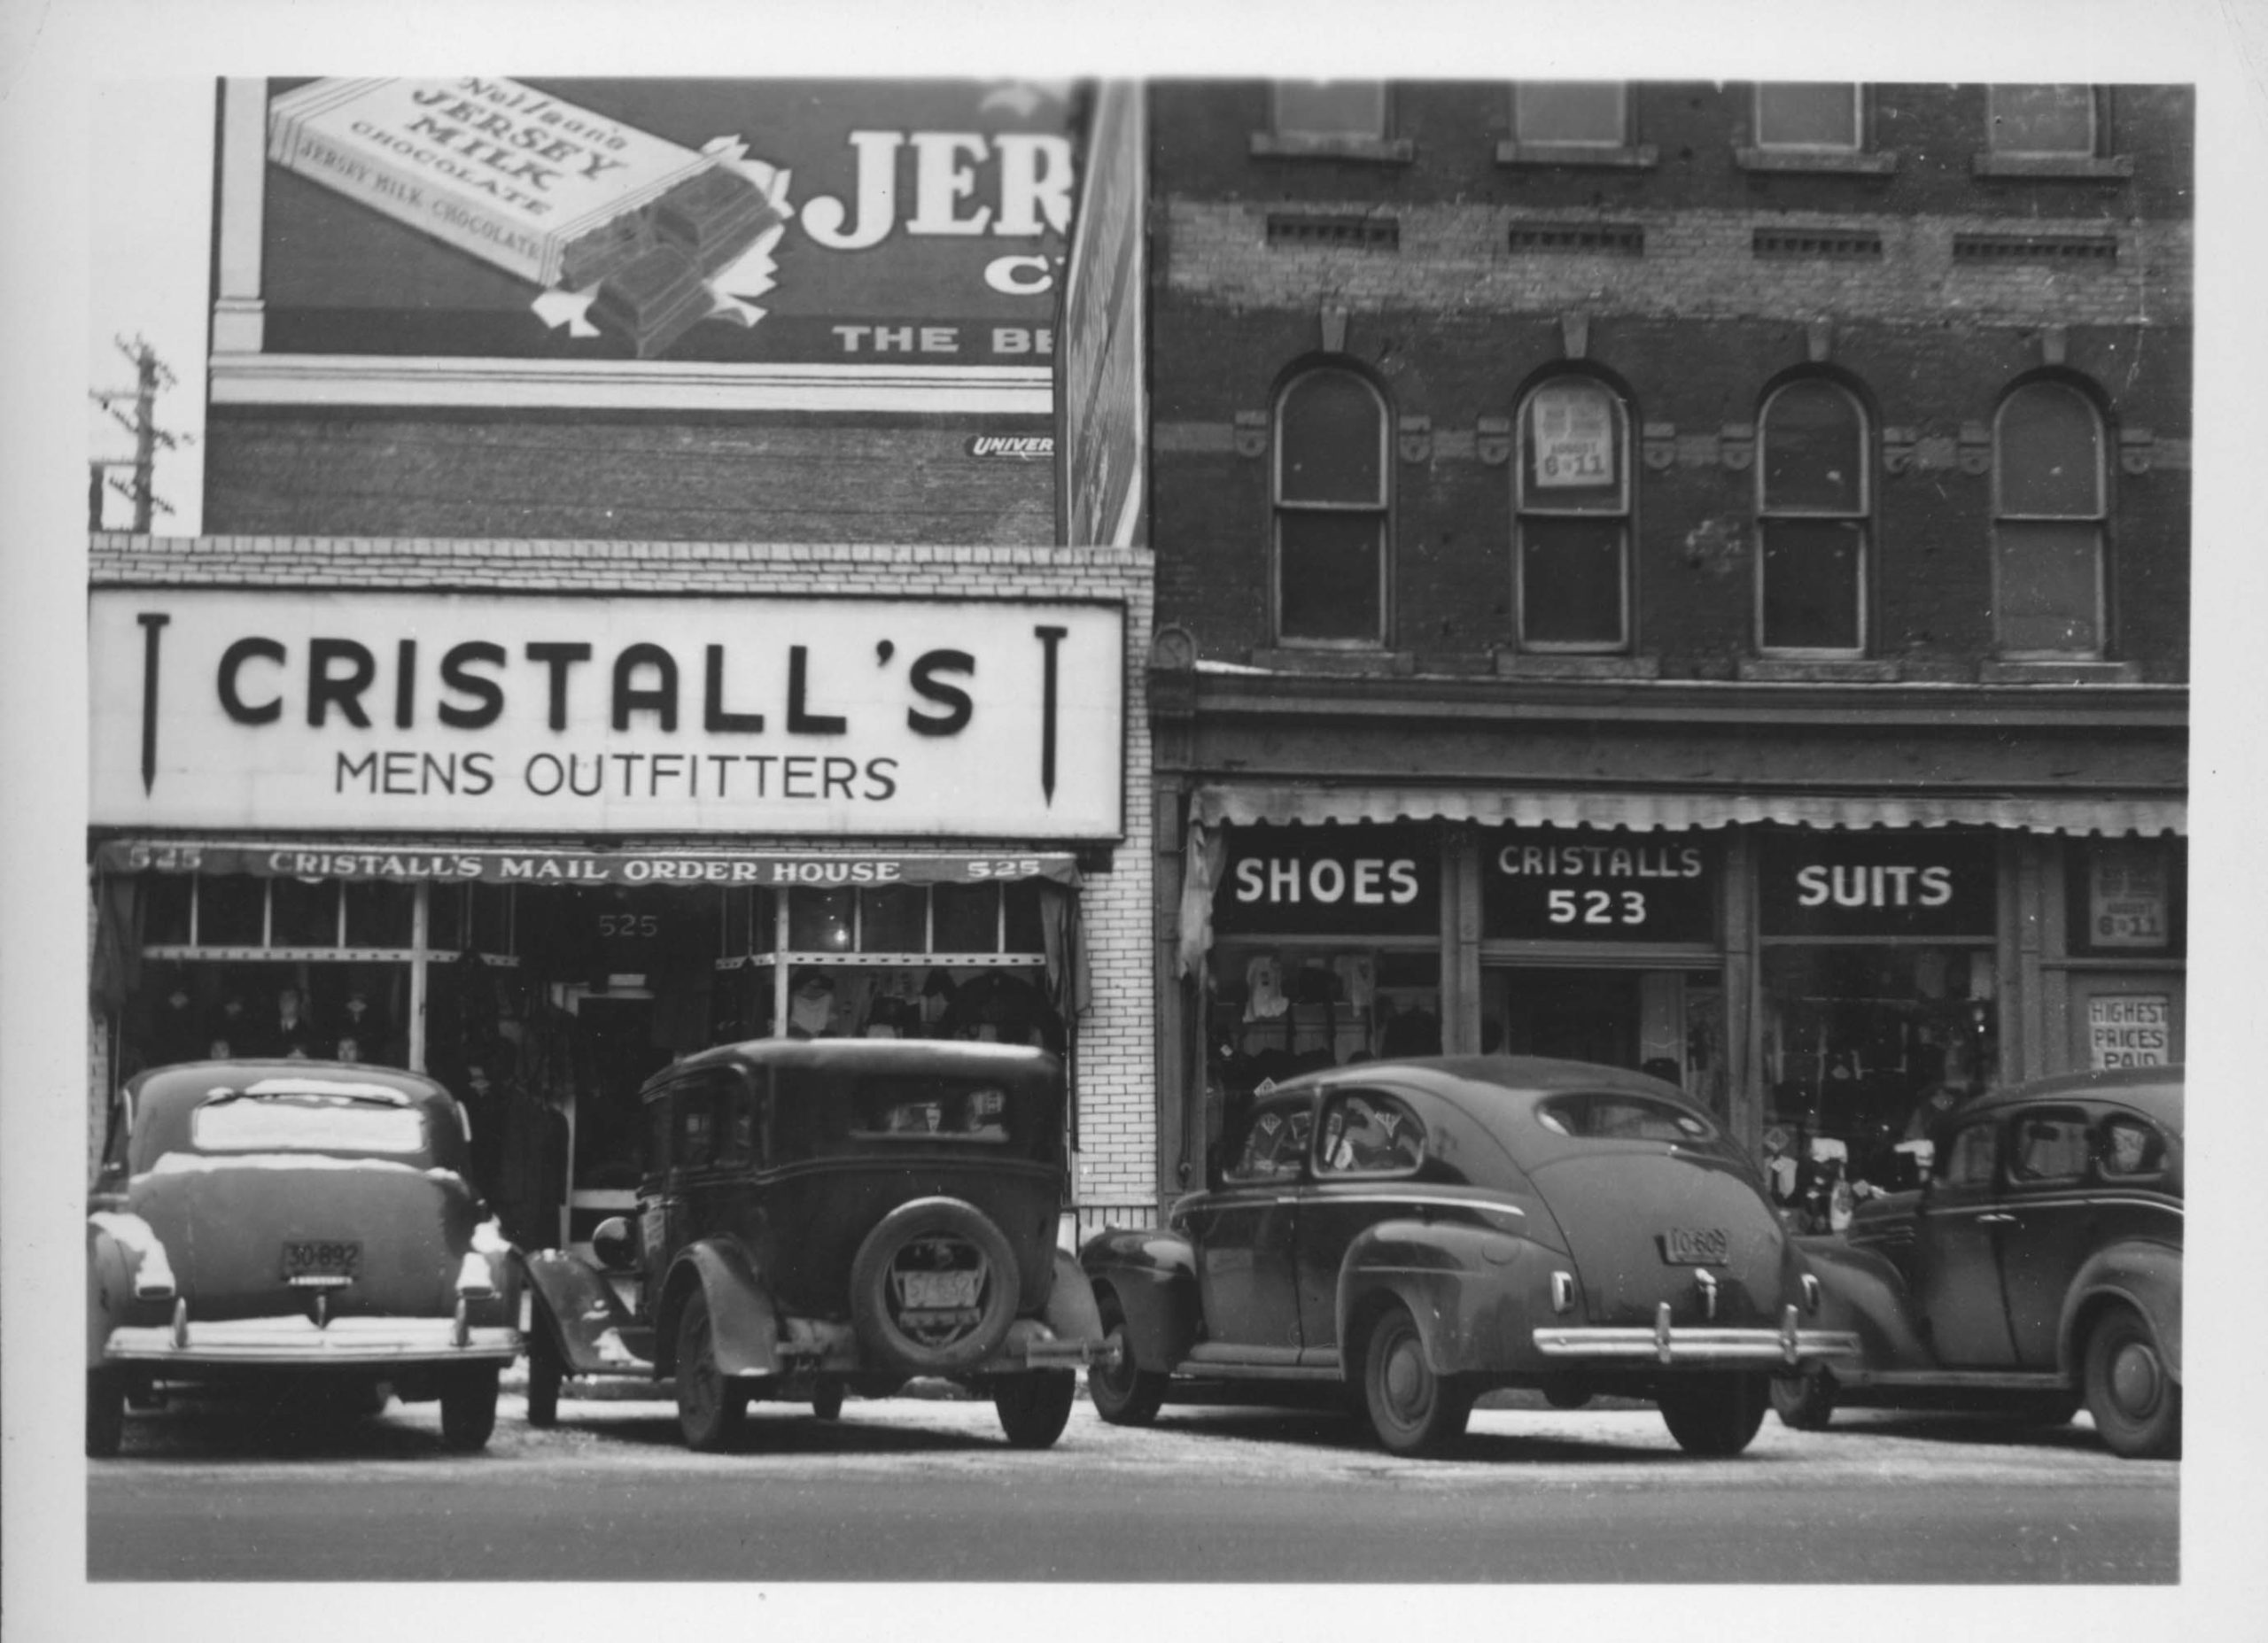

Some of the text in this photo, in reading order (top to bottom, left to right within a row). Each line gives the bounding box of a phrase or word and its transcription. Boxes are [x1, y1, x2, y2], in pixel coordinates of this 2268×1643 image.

[406, 115, 564, 191] MILK
[412, 88, 628, 180] JERSEY
[351, 120, 554, 216] CHOCOLATE
[299, 140, 543, 260] JERSEY MILK CHOCOLATE
[984, 254, 1066, 295] C
[832, 326, 959, 353] THE
[217, 636, 976, 737] CRISTALL'S
[335, 750, 899, 801] MENS OUTFITTERS
[129, 847, 1041, 882] 525 CRISTALL'S MAIL ORDER HOUSE 525
[1236, 857, 1419, 904] SHOES
[1499, 845, 1703, 878] CRISTALLS
[1797, 864, 1953, 908] SUITS
[598, 914, 658, 938] 525
[1548, 889, 1647, 925] 523
[2092, 1002, 2169, 1023] HIGHEST
[2094, 1028, 2163, 1049] PRICES
[2104, 1051, 2157, 1071] PAID
